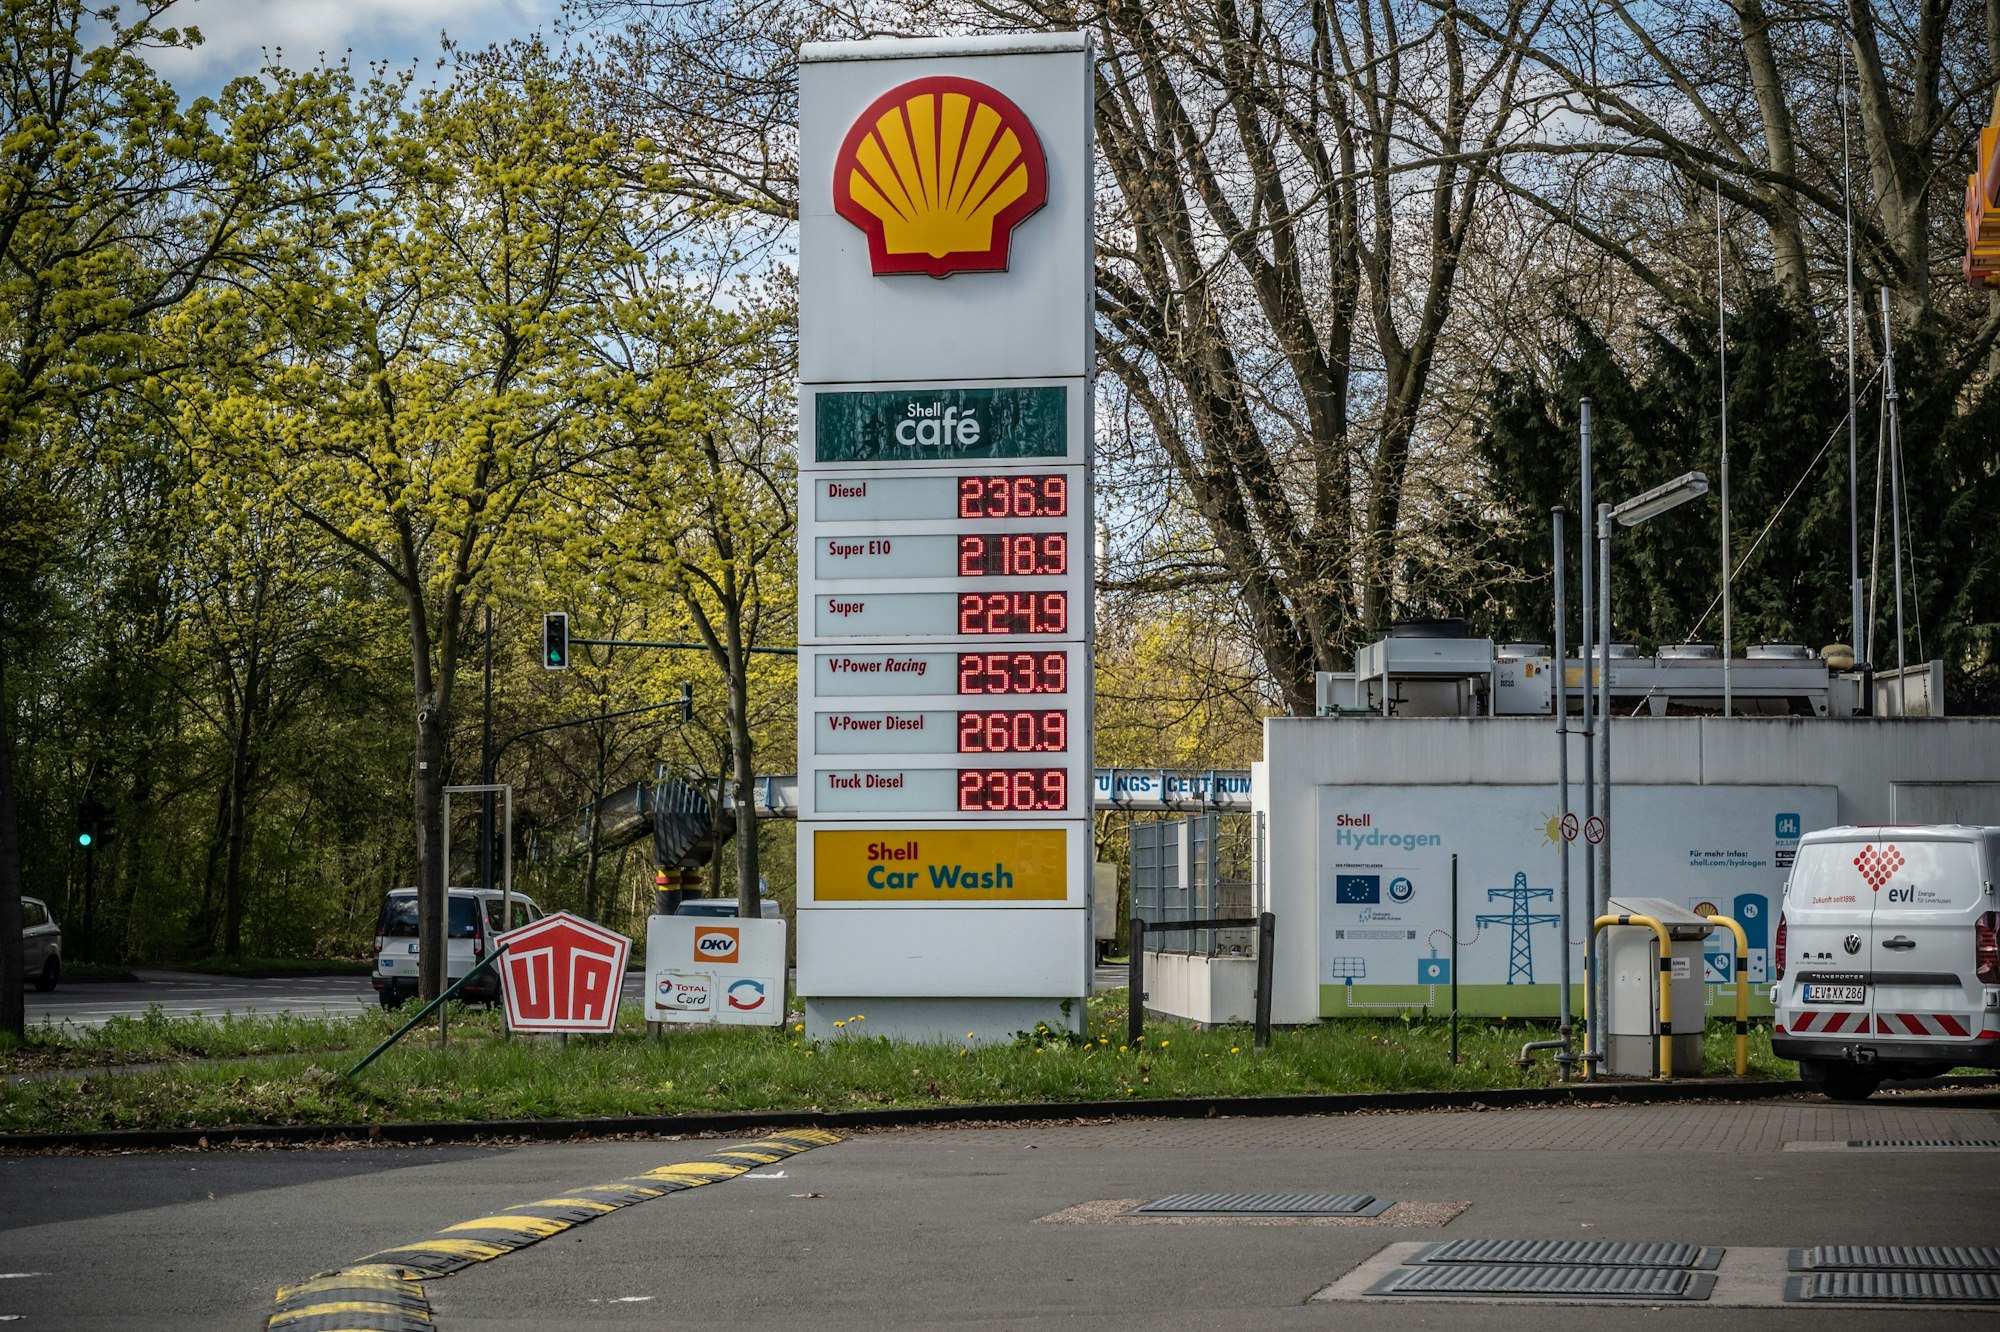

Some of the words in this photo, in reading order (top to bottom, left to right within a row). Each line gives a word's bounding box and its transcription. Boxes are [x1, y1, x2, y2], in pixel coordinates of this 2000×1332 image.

[907, 403, 941, 418] Shell
[895, 406, 981, 446] café
[828, 482, 867, 498] Diesel
[961, 477, 1066, 518] 236.9
[828, 541, 865, 559] Super
[868, 540, 891, 555] E10
[828, 600, 865, 617] Super
[961, 593, 1066, 634] 224.9
[828, 659, 882, 673] V-Power
[884, 658, 927, 676] Racing
[961, 654, 1066, 694] 253.9
[828, 716, 884, 731] V-Power
[886, 715, 924, 730] Diesel
[961, 712, 1066, 752] 260.9
[828, 774, 861, 788] Truck
[865, 773, 904, 788] Diesel
[960, 771, 1065, 811] 236.9
[1336, 813, 1371, 827] Shell
[1336, 828, 1441, 851] Hydrogen
[867, 842, 919, 861] Shell
[1689, 859, 1767, 868] shell.com/hydrogen
[867, 865, 919, 889] Car
[928, 863, 1013, 889] Wash
[1812, 896, 1833, 904] Zukunft
[1888, 884, 1915, 903] evl
[700, 939, 734, 951] DKV
[508, 924, 616, 1020] UTA
[675, 984, 708, 993] TOTAL
[1809, 986, 1826, 999] LEV
[1832, 987, 1844, 999] XX
[1845, 987, 1862, 999] 286
[676, 992, 707, 1005] Card
